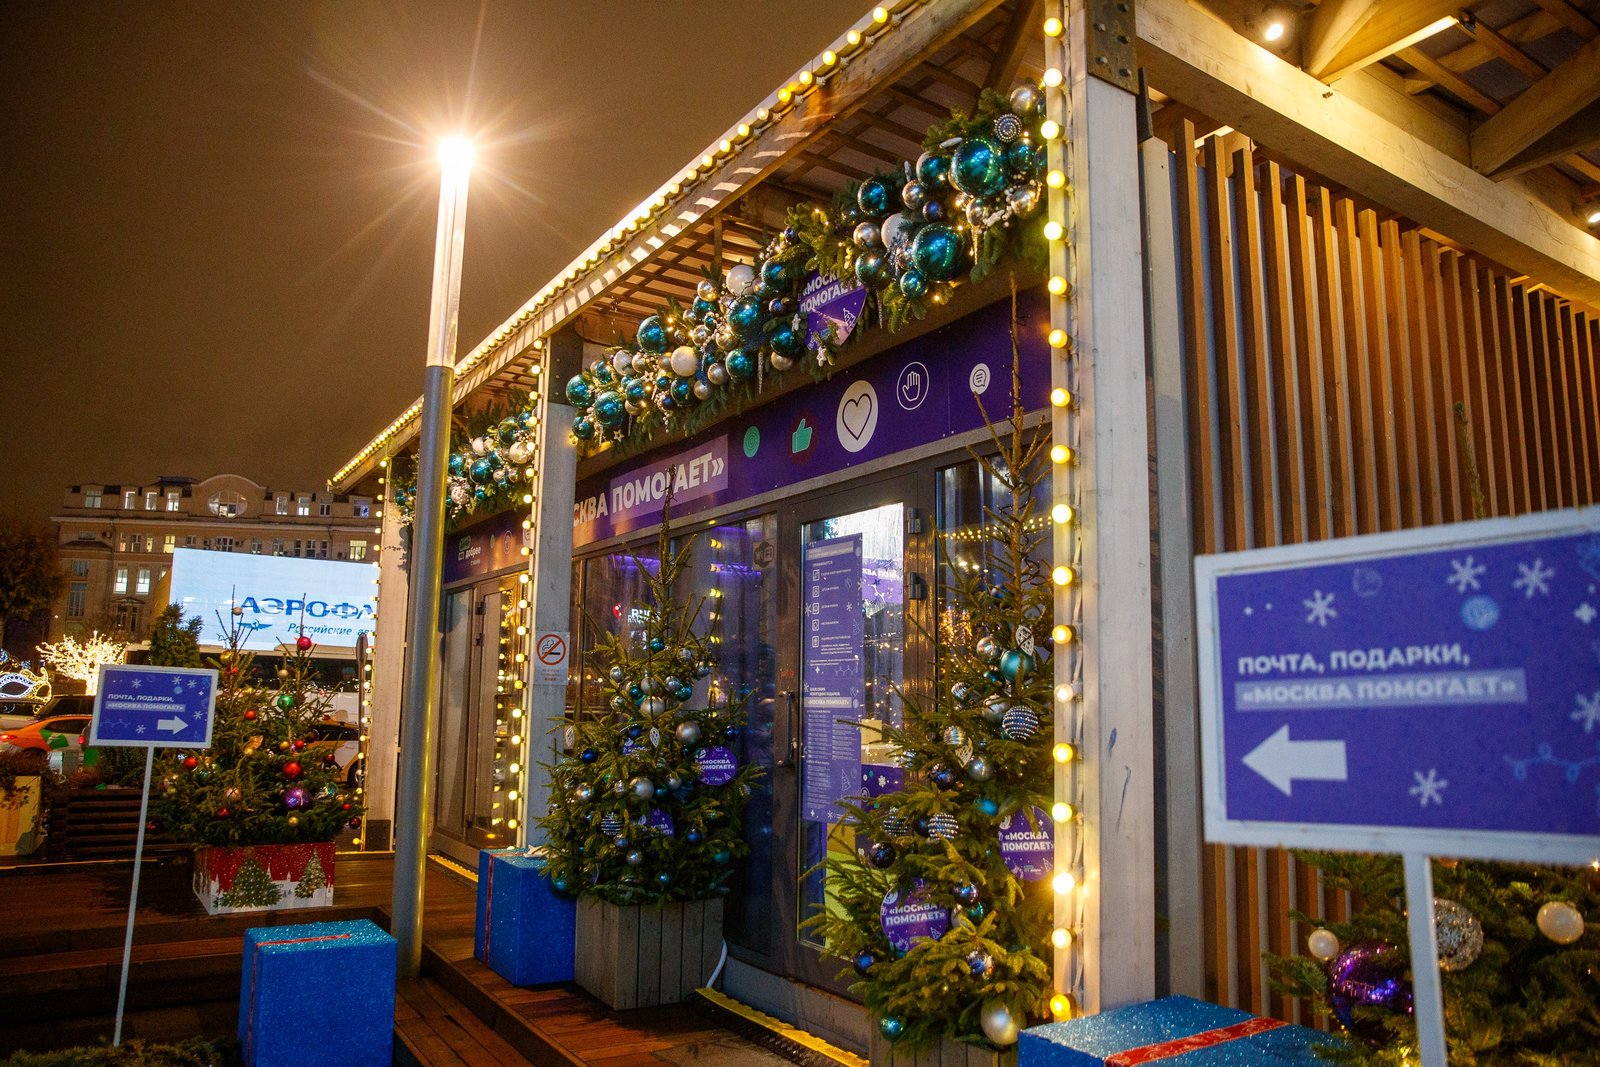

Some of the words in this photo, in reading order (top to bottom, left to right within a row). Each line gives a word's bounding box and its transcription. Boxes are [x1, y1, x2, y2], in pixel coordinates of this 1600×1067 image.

[803, 270, 840, 297] «МОСК
[573, 493, 609, 528] СКВА
[241, 596, 374, 620] АЭРОФЛ
[287, 623, 353, 636] Российские
[1238, 653, 1325, 675] ПОЧТА,
[1330, 642, 1470, 671] ПОДАРКИ,
[107, 693, 135, 701] ПОЧТА,
[136, 694, 175, 703] ПОДАРКИ,
[1242, 680, 1353, 704] «МОСКВА
[1357, 675, 1518, 699] ПОМОГАЕТ»
[1005, 830, 1050, 841] «МОСКВА
[886, 911, 945, 926] ПОМОГАЕТ»
